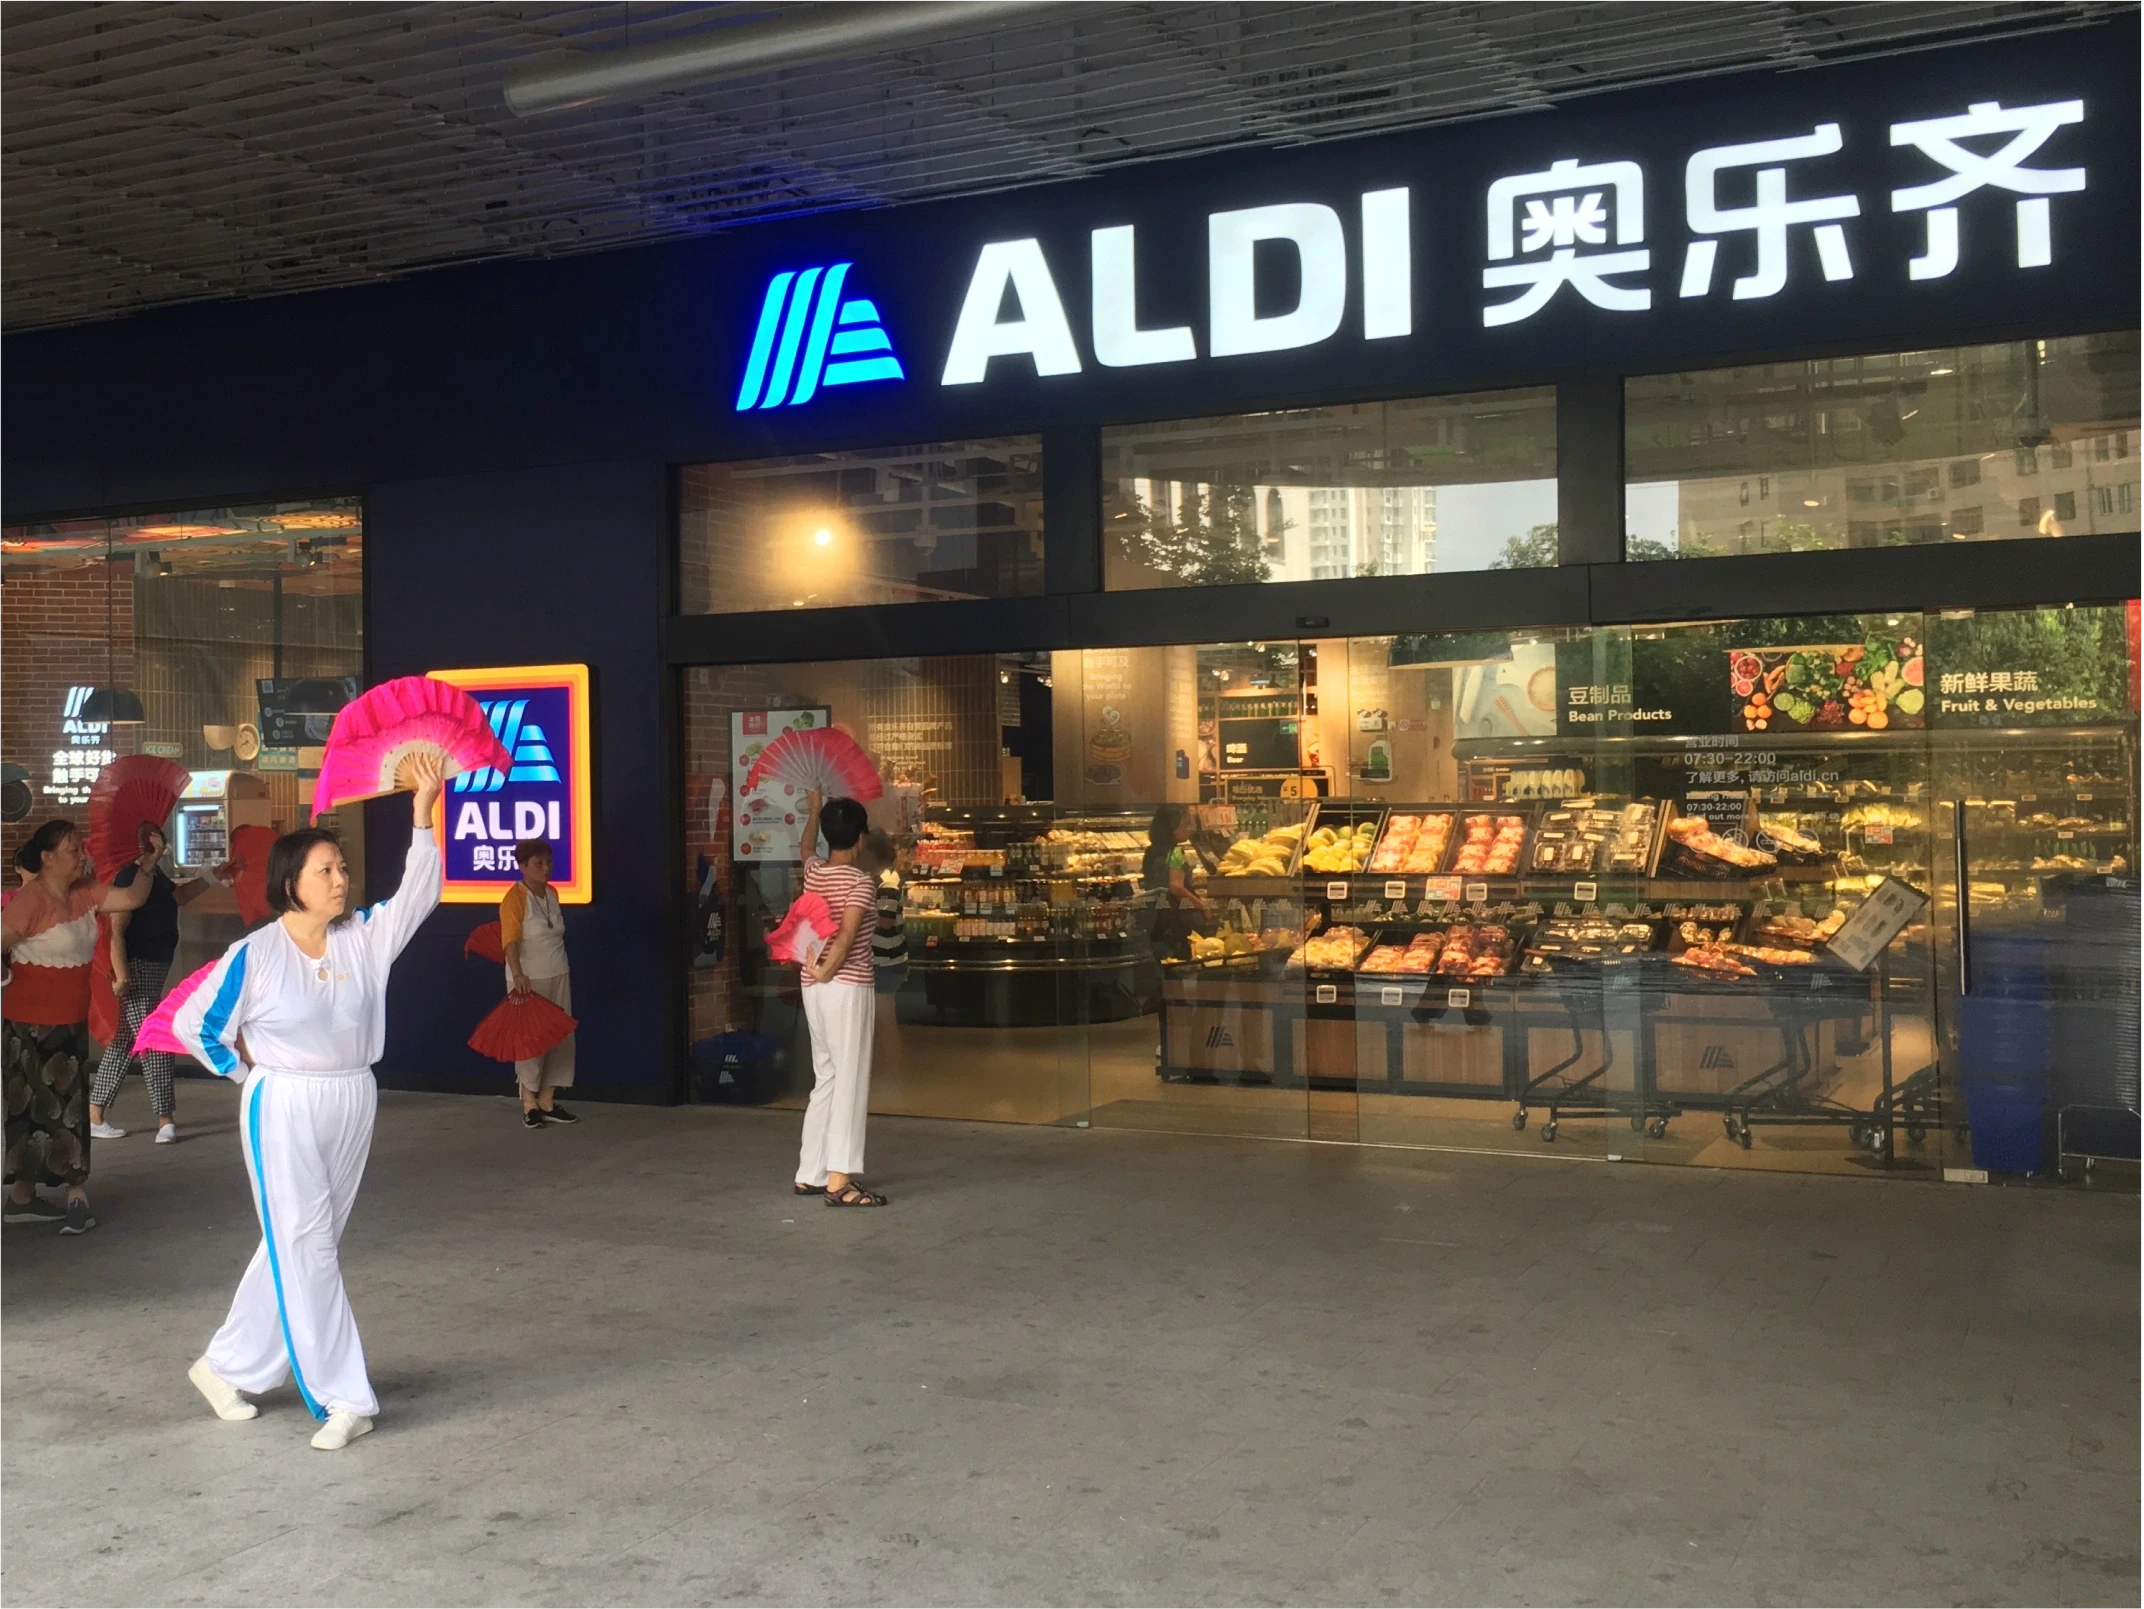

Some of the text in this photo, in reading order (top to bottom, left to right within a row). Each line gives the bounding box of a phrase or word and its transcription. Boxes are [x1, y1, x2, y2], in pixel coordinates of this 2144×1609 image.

[942, 99, 2087, 386] ALDI 奥乐齐
[1940, 670, 2038, 694] 新鲜果蔬
[1568, 685, 1631, 705] 豆制品
[1941, 696, 2097, 714] Fruit & Vegetables
[1569, 708, 1672, 722] Bean Products
[1684, 751, 1777, 766] 07:30-22:00
[52, 767, 101, 784] 触手可
[81, 785, 92, 794] th
[1686, 802, 1742, 812] 07:30-22:00
[454, 800, 561, 840] ALDI
[472, 844, 521, 872] 奥乐
